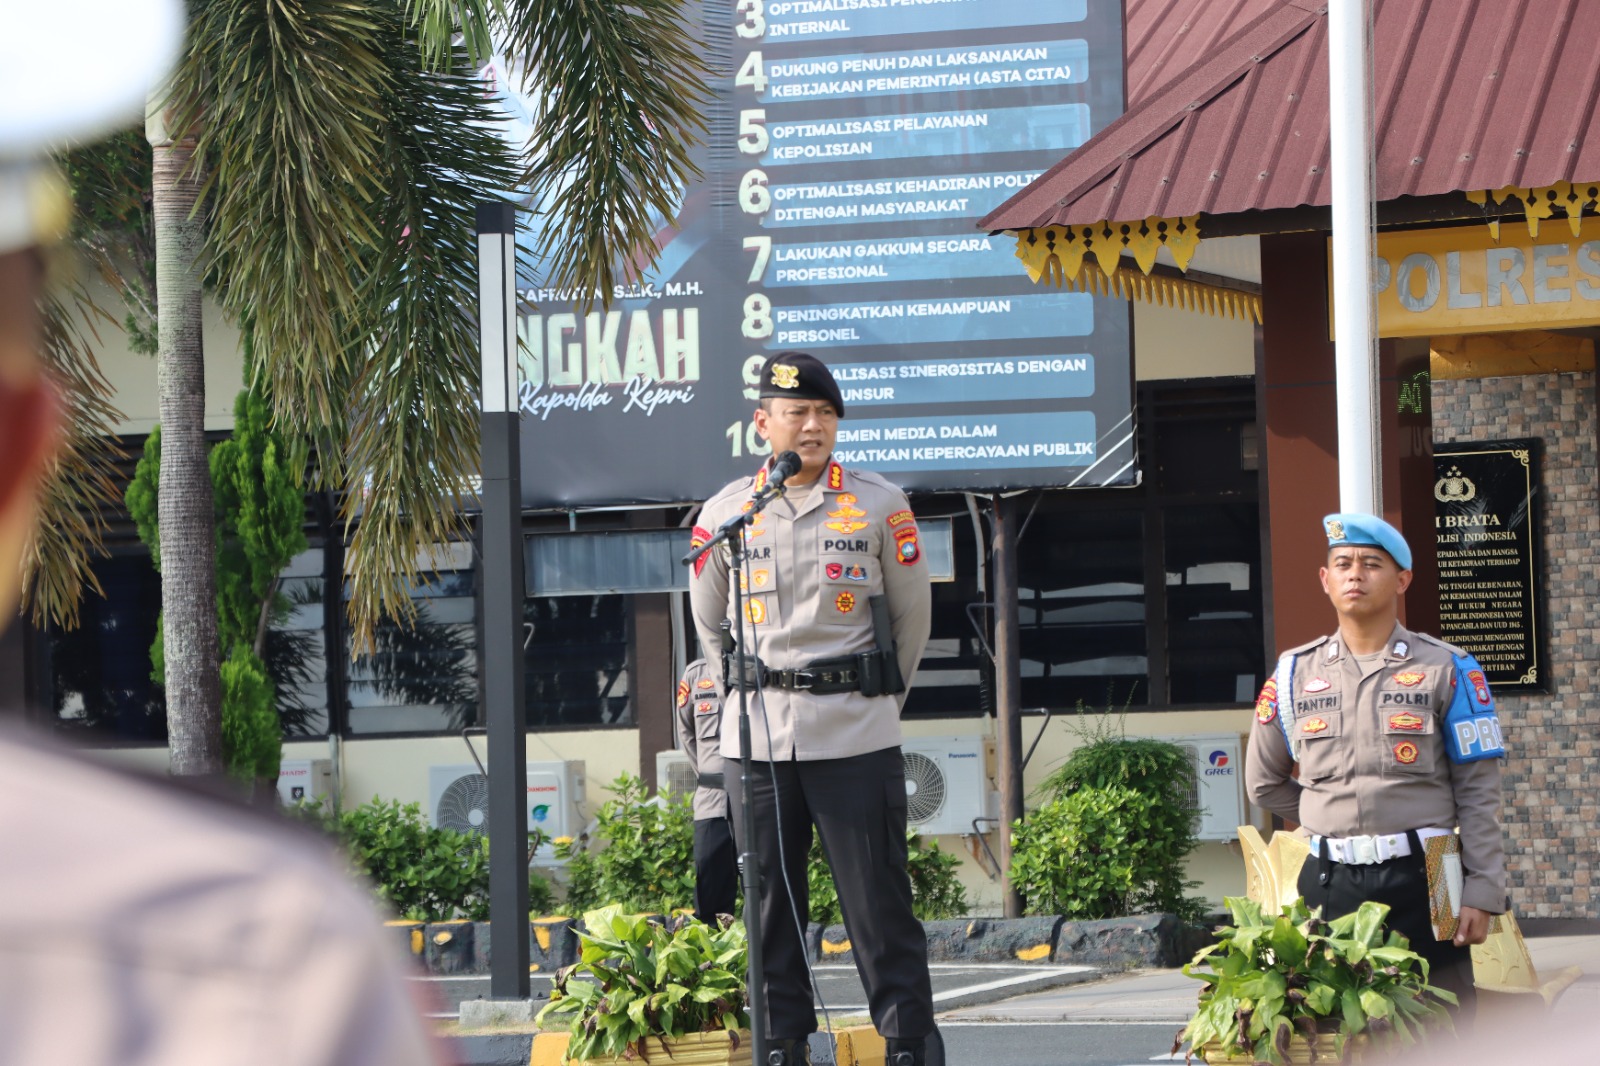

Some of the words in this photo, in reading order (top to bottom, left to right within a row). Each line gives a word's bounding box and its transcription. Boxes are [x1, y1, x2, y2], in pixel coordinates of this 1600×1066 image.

[736, 0, 767, 38] 3
[769, 19, 850, 36] INTERNAL
[771, 61, 839, 78] DUKUNG
[842, 56, 896, 73] PENUH
[899, 54, 933, 70] DAN
[936, 47, 1047, 66] LAKSANAKAN
[735, 51, 768, 92] 4
[771, 79, 864, 98] KEBIJAKAN
[867, 73, 970, 92] PEMERINTAH
[973, 68, 1022, 86] (ASTA
[1025, 65, 1071, 83] CITA)
[737, 109, 769, 155] 5
[773, 120, 891, 139] OPTIMALISASI
[893, 114, 988, 132] PELAYANAN
[773, 142, 872, 160] KEPOLISIAN
[738, 168, 771, 214] 6
[774, 181, 892, 201] OPTIMALISASI
[895, 176, 990, 194] KEHADIRAN
[775, 204, 858, 221] DITENGAH
[861, 198, 968, 217] MASYARAKAT
[776, 246, 852, 263] LAKUKAN
[854, 241, 925, 258] GAKKUM
[927, 238, 991, 254] SECARA
[742, 235, 772, 284] 7
[776, 265, 887, 282] PROFESIONAL
[666, 282, 703, 296] M.H.
[741, 293, 774, 339] 8
[777, 305, 904, 323] PENINGKATKAN
[907, 300, 1010, 317] KEMAMPUAN
[778, 327, 859, 343] PERSONEL
[830, 366, 896, 381] ALISASI
[899, 361, 1015, 378] SINERGISITAS
[1017, 358, 1086, 374] DENGAN
[518, 380, 613, 421] Kapolda
[622, 376, 694, 417] Kepri
[841, 387, 894, 401] UNSUR
[884, 426, 937, 440] MEDIA
[940, 424, 997, 438] DALAM
[831, 448, 910, 463] GKATKAN
[913, 444, 1031, 461] KEPERCAYAAN
[1033, 441, 1093, 456] PUBLIK
[1445, 514, 1501, 528] BRATA
[1464, 531, 1517, 541] INDONESIA
[824, 539, 868, 552] POLRI
[1477, 549, 1491, 557] DAN
[1492, 548, 1518, 556] BANGSA
[1440, 570, 1459, 578] MAHA
[1450, 582, 1475, 590] TINGGI
[1459, 602, 1485, 610] HUKUM
[1492, 601, 1522, 609] NEGARA
[1469, 611, 1504, 619] INDONESIA
[1505, 610, 1523, 618] YANG
[1484, 633, 1525, 641] MENGAYOMI
[1496, 643, 1525, 651] DENGAN
[1297, 696, 1337, 714] FANTRI
[1383, 693, 1429, 706] POLRI
[1205, 768, 1234, 776] GREE
